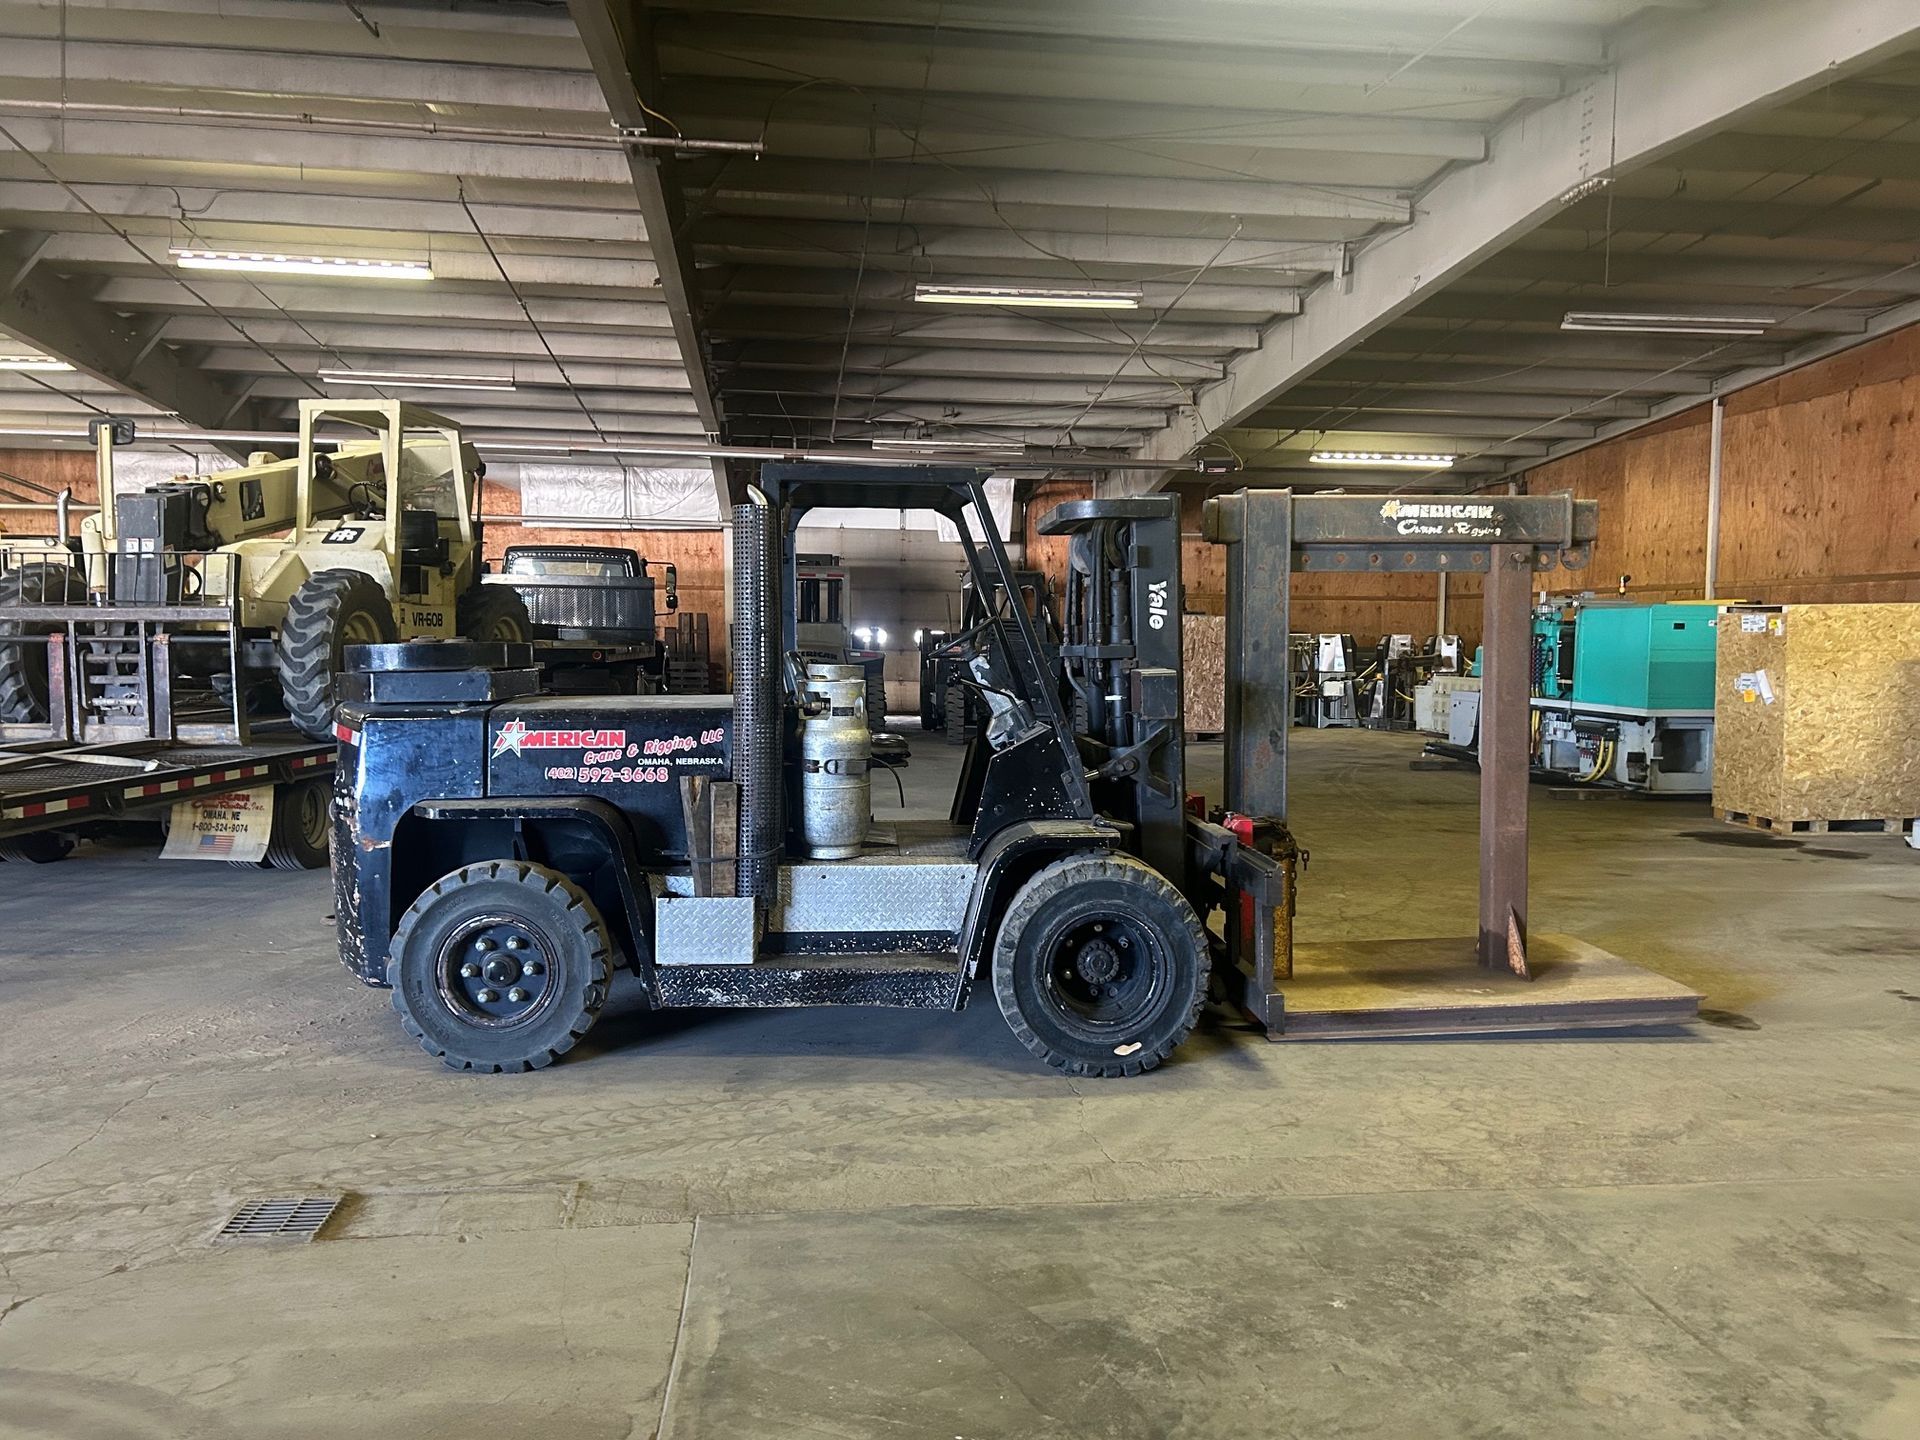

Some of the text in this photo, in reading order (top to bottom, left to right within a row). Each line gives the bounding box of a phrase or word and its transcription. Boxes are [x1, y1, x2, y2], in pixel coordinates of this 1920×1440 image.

[1380, 500, 1494, 519] AMERICAN
[1148, 580, 1168, 630] Yale
[492, 719, 626, 755] AMERICAN
[584, 728, 724, 765] Crane & Rigging, LLC
[637, 757, 724, 767] OMAHA, NEBRASKA
[544, 766, 669, 783] (402) 592-3668
[231, 811, 241, 821] NE
